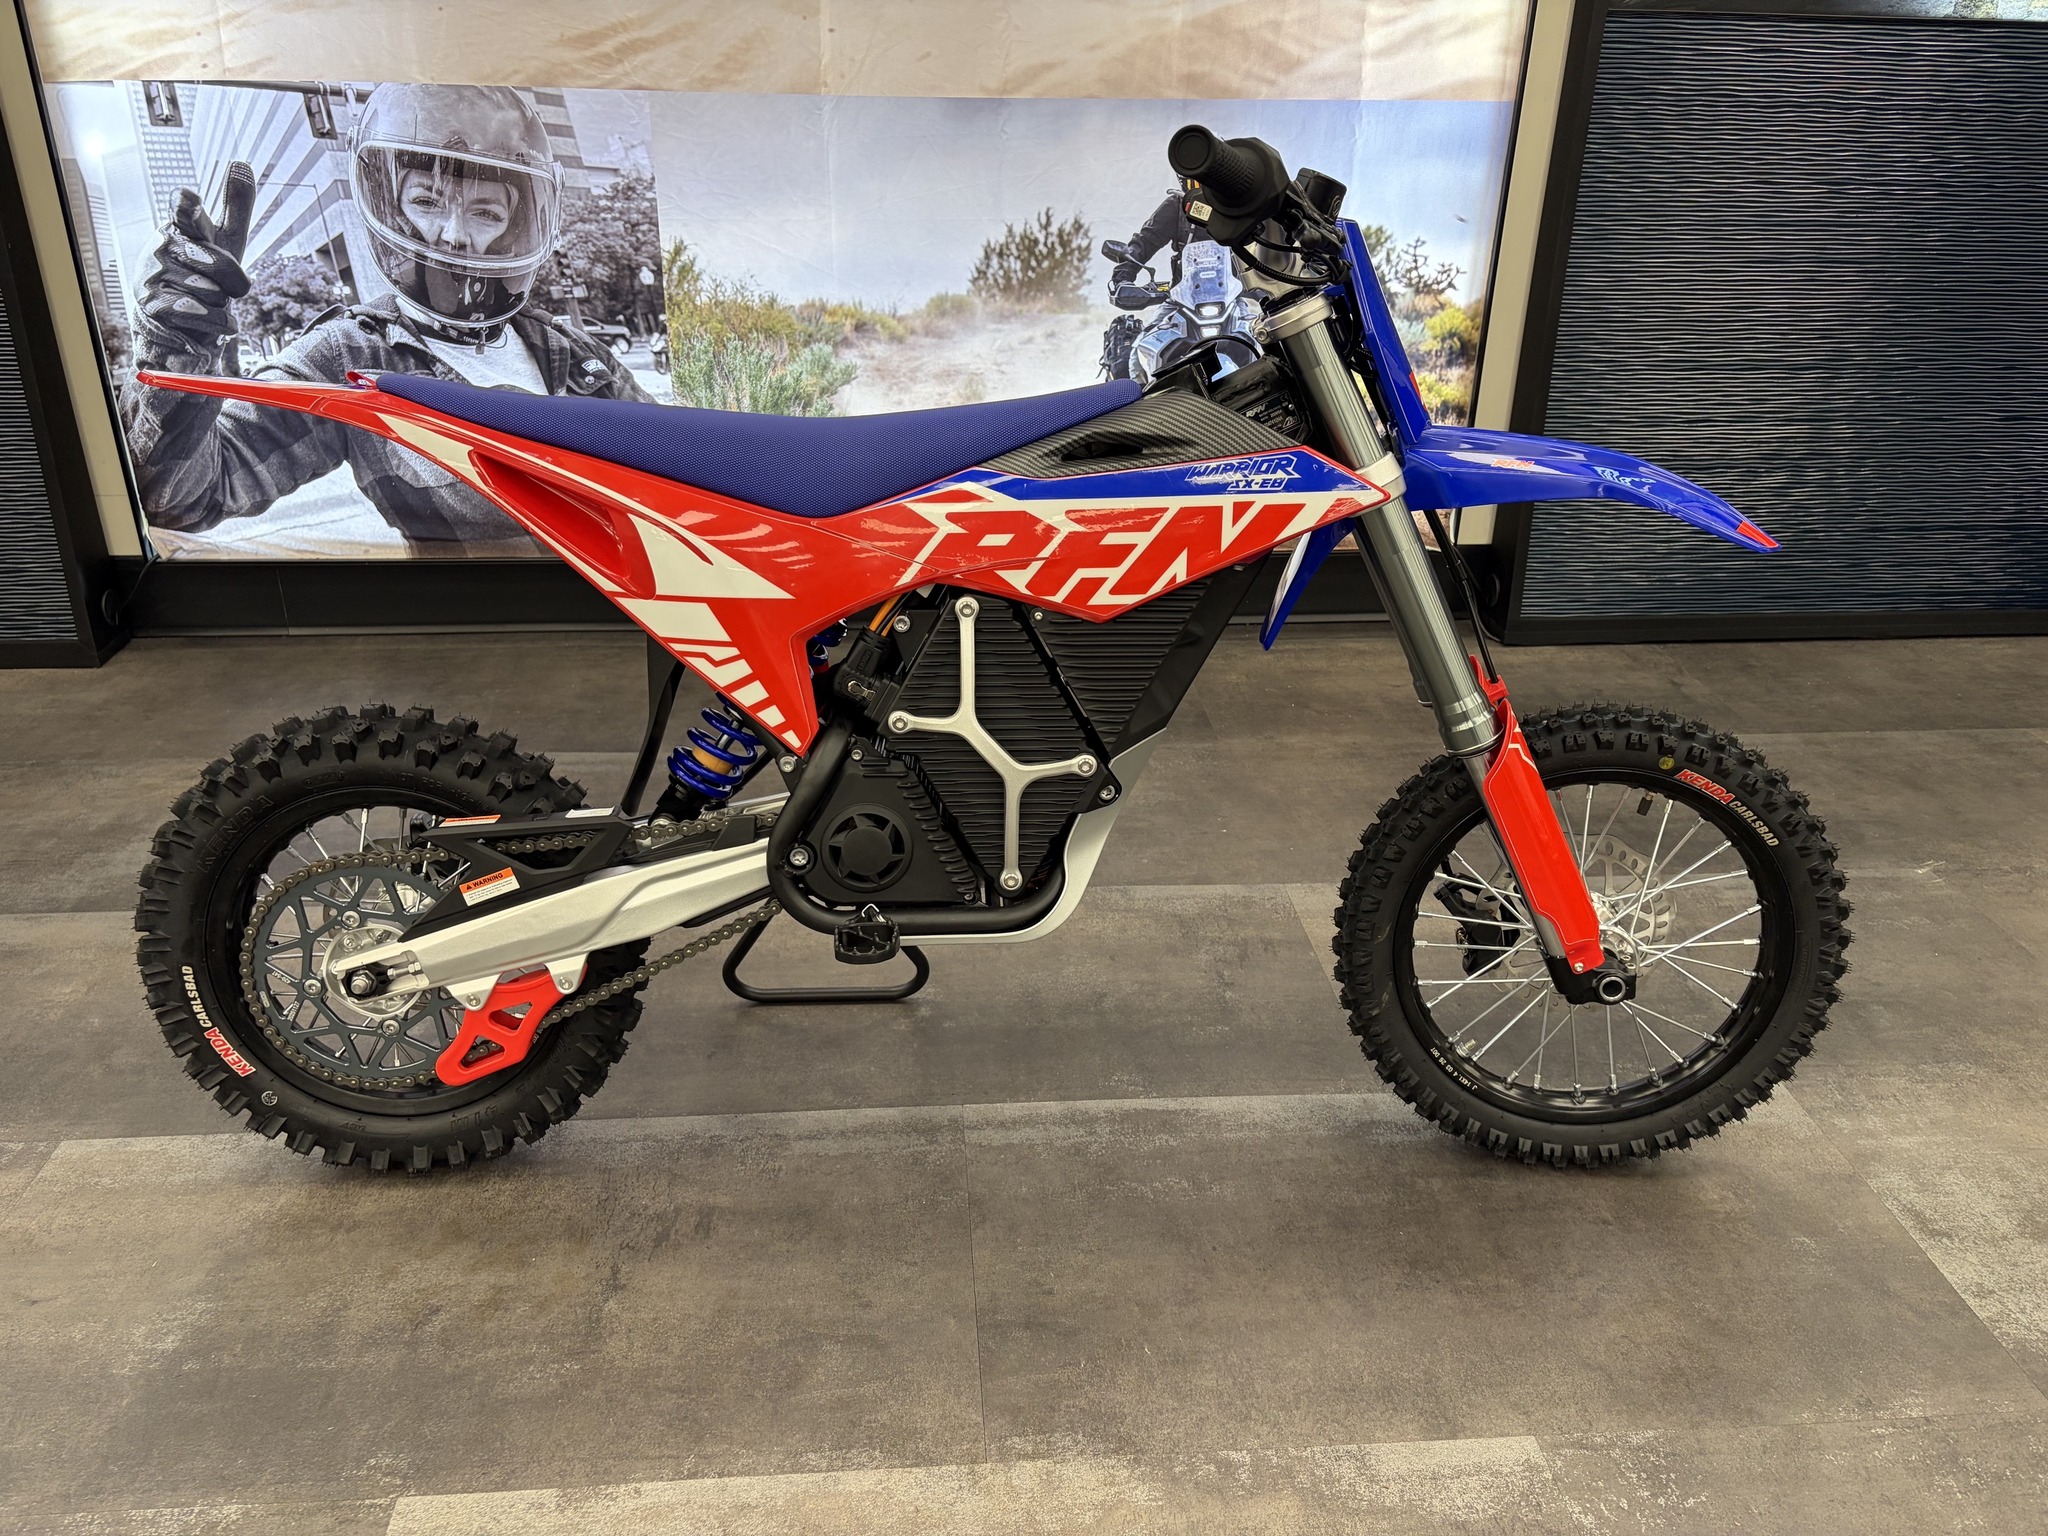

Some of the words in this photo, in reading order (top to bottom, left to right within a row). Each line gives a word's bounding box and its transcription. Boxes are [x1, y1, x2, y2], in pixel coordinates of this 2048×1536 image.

[1185, 454, 1302, 481] WARRIOR
[1491, 458, 1535, 469] RFN
[918, 502, 1305, 605] RFN
[1674, 768, 1736, 805] KENDA
[1728, 800, 1780, 847] CARLSBAD
[472, 872, 504, 888] WARNING
[181, 965, 213, 1028] CARLSBAD
[204, 1026, 257, 1077] KENDA
[1431, 1047, 1440, 1058] DOT
